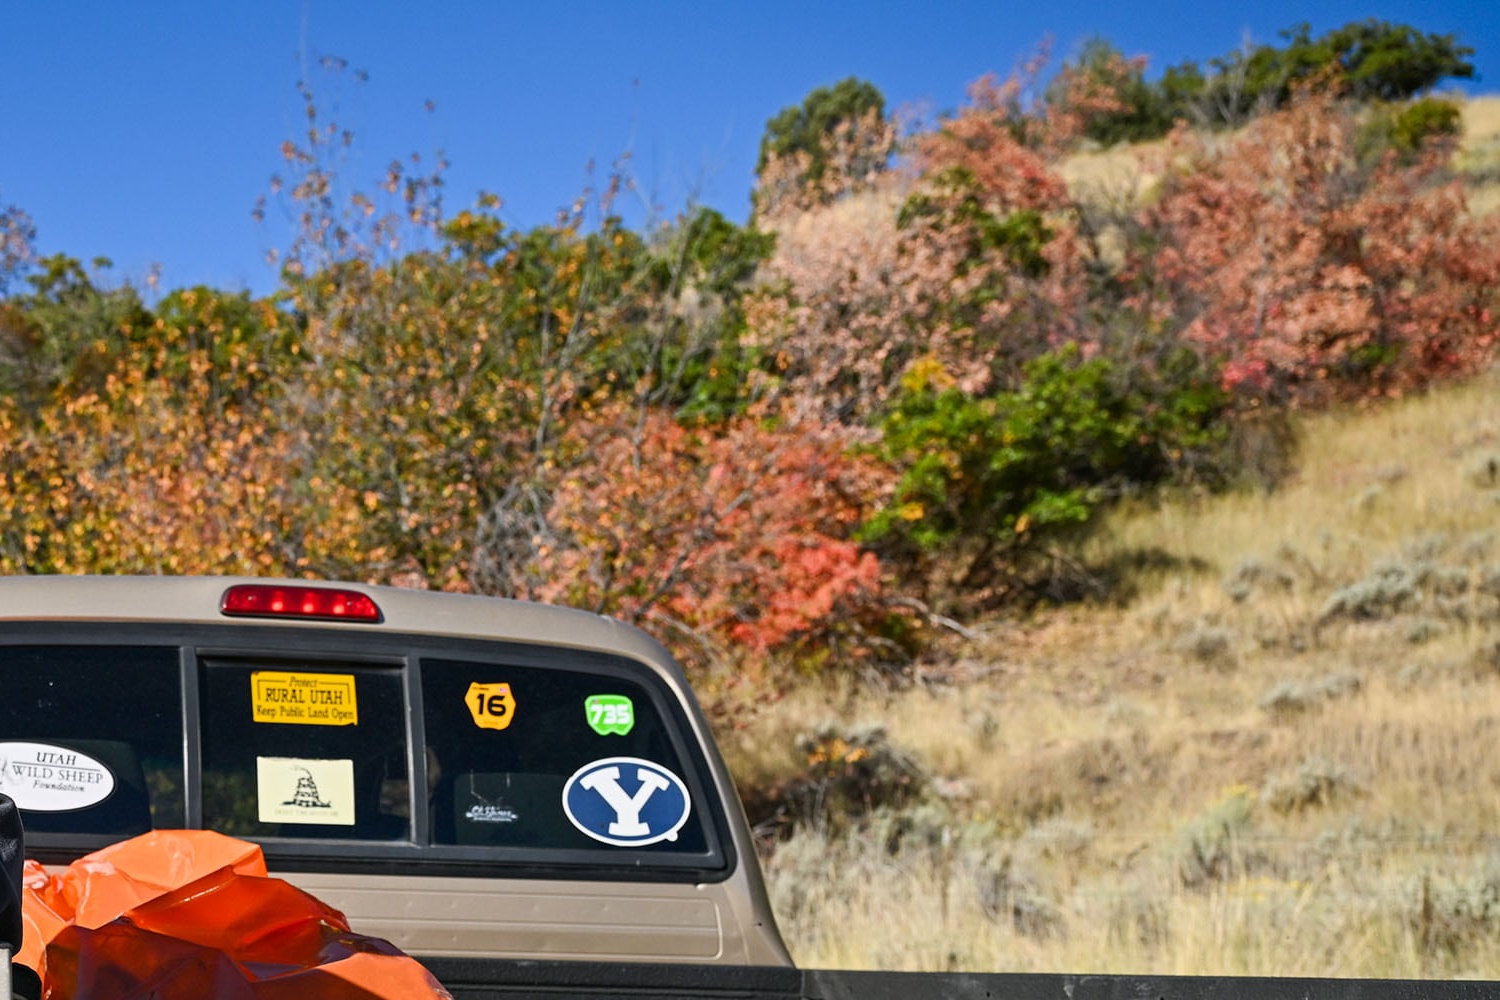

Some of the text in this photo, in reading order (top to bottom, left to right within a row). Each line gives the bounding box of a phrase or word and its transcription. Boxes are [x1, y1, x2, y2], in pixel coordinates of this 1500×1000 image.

[265, 688, 343, 705] RURAL UTAH
[476, 693, 507, 717] 16
[256, 705, 354, 721] Keep Public Land Open
[589, 703, 631, 725] 735
[36, 751, 76, 765] UTAH
[11, 764, 103, 784] WILD SHEEP
[33, 780, 84, 792] Foundation
[579, 766, 671, 837] Y
